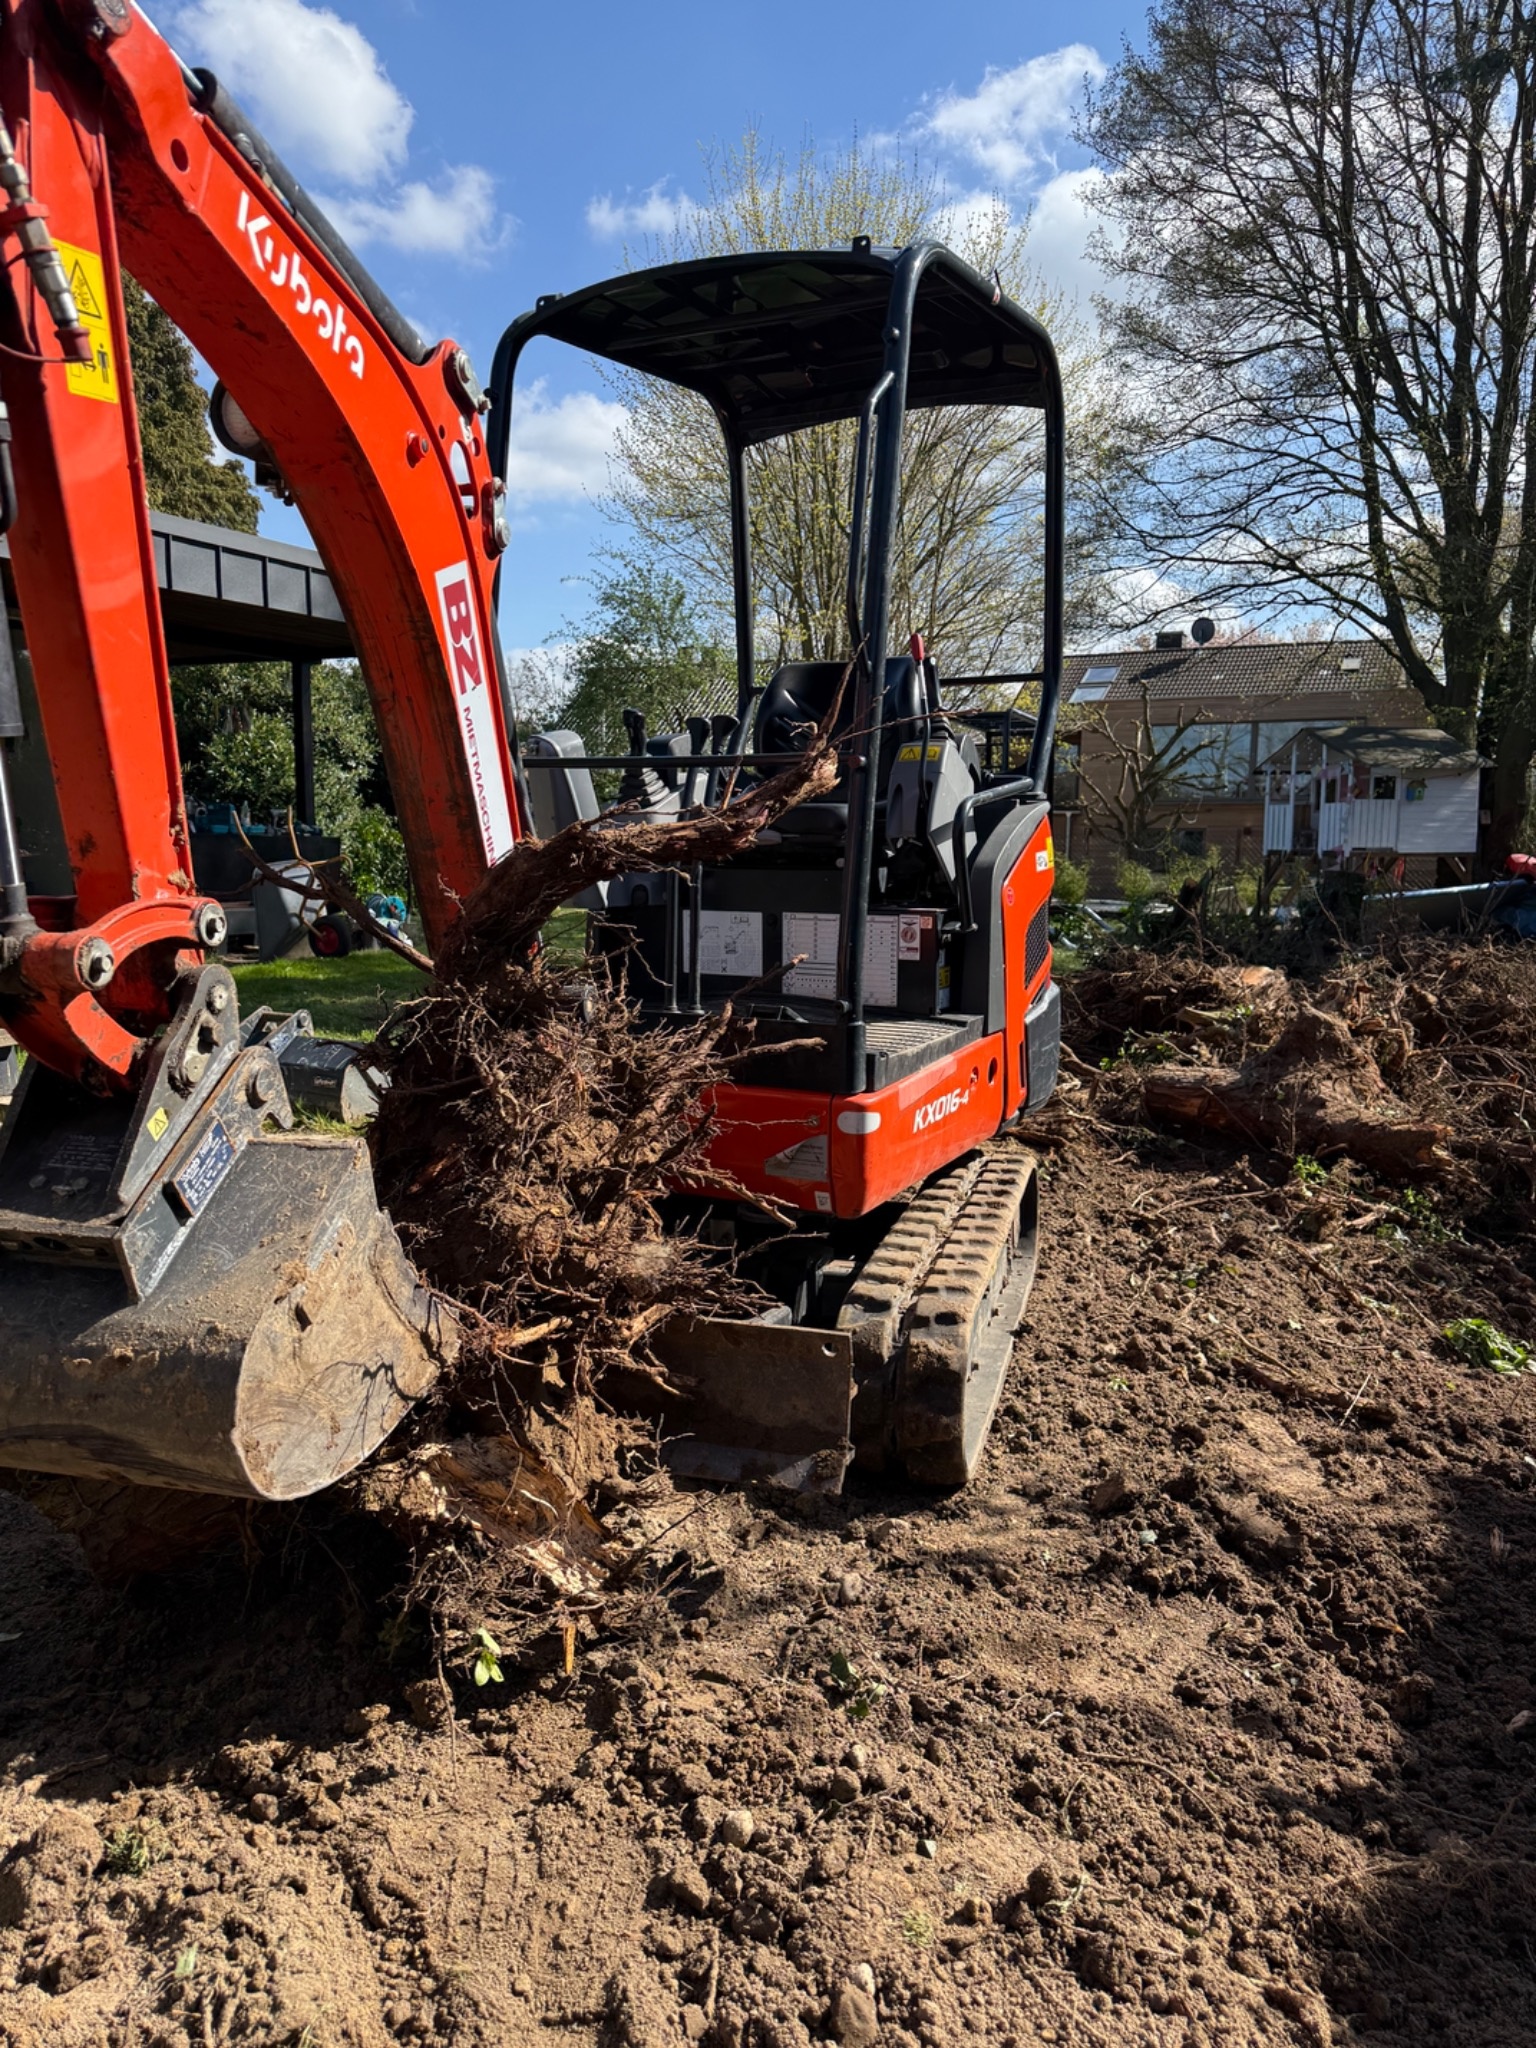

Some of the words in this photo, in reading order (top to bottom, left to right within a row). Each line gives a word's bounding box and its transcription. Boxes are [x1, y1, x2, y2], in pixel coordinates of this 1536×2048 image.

[237, 190, 365, 380] Kubota
[443, 578, 483, 695] BZ
[462, 706, 497, 867] MIETMASCHIN
[913, 1088, 970, 1134] KX016-4
